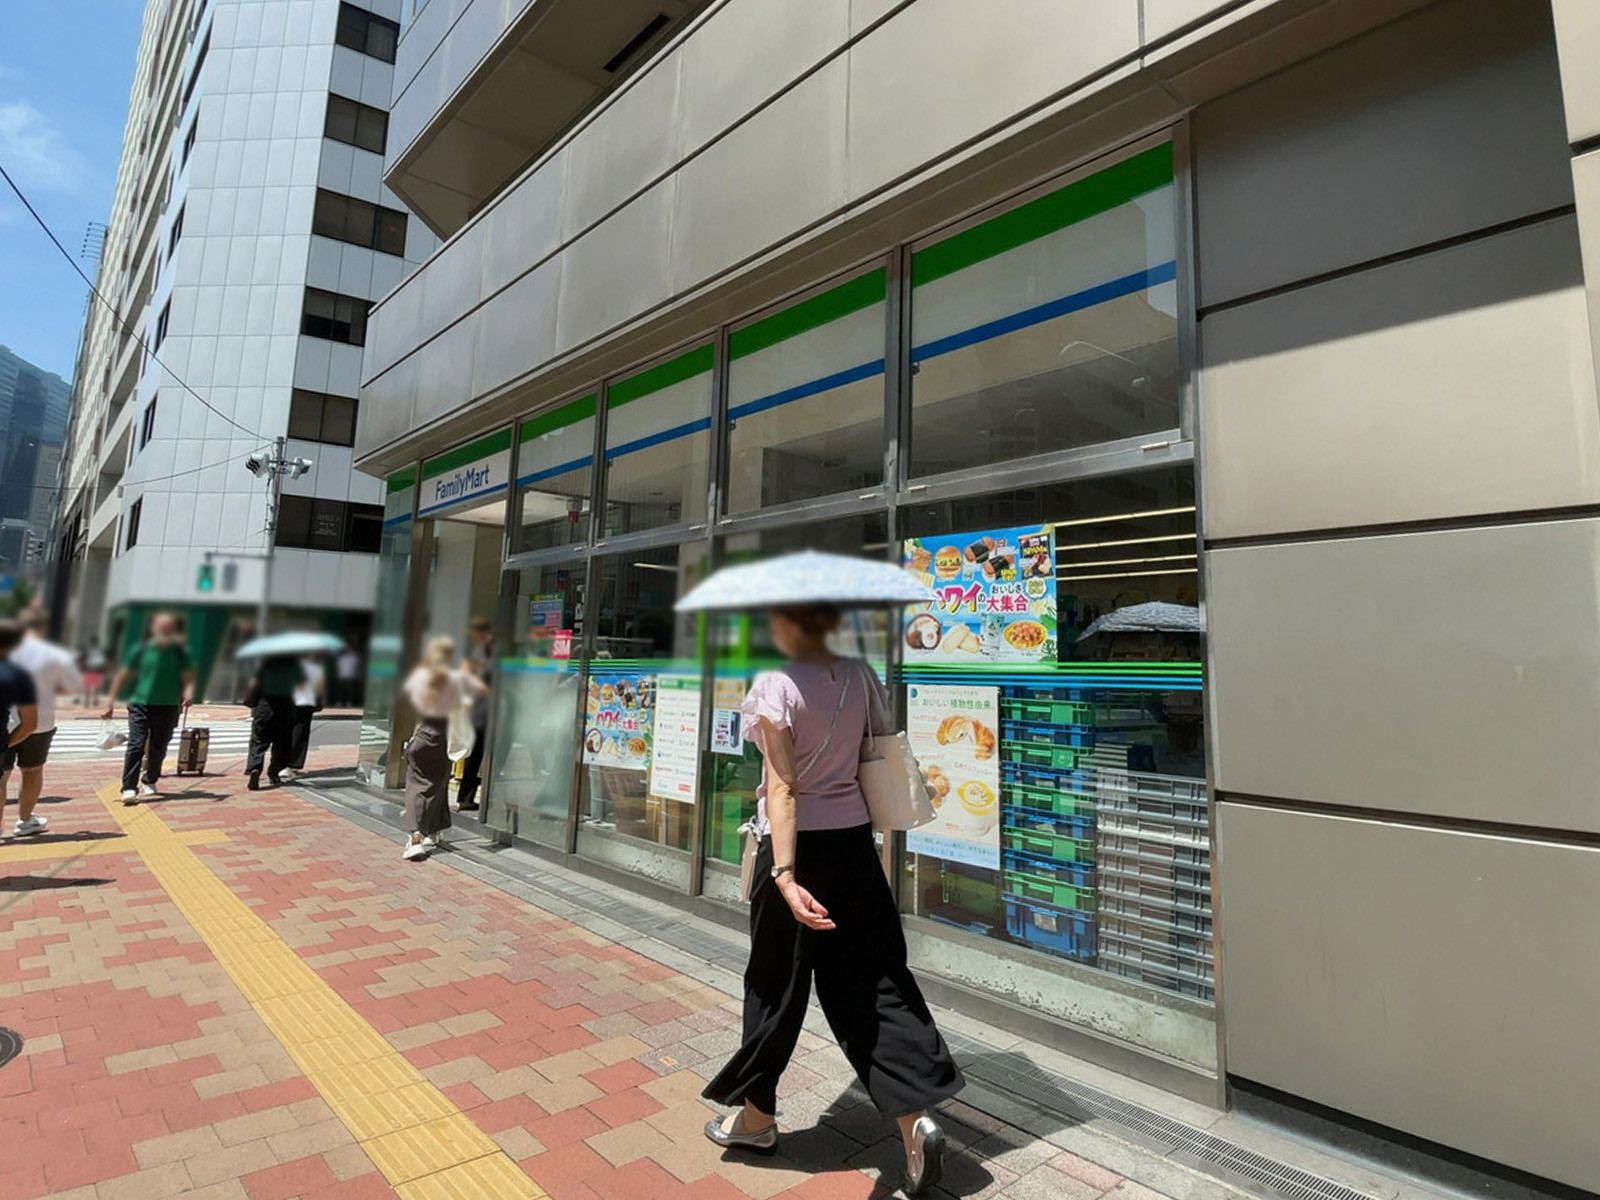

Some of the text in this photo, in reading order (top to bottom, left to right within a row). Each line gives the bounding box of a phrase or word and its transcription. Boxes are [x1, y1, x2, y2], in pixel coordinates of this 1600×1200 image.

[435, 464, 490, 501] FamilyMart
[991, 584, 1022, 594] おいしさ
[986, 594, 1028, 612] 大集合
